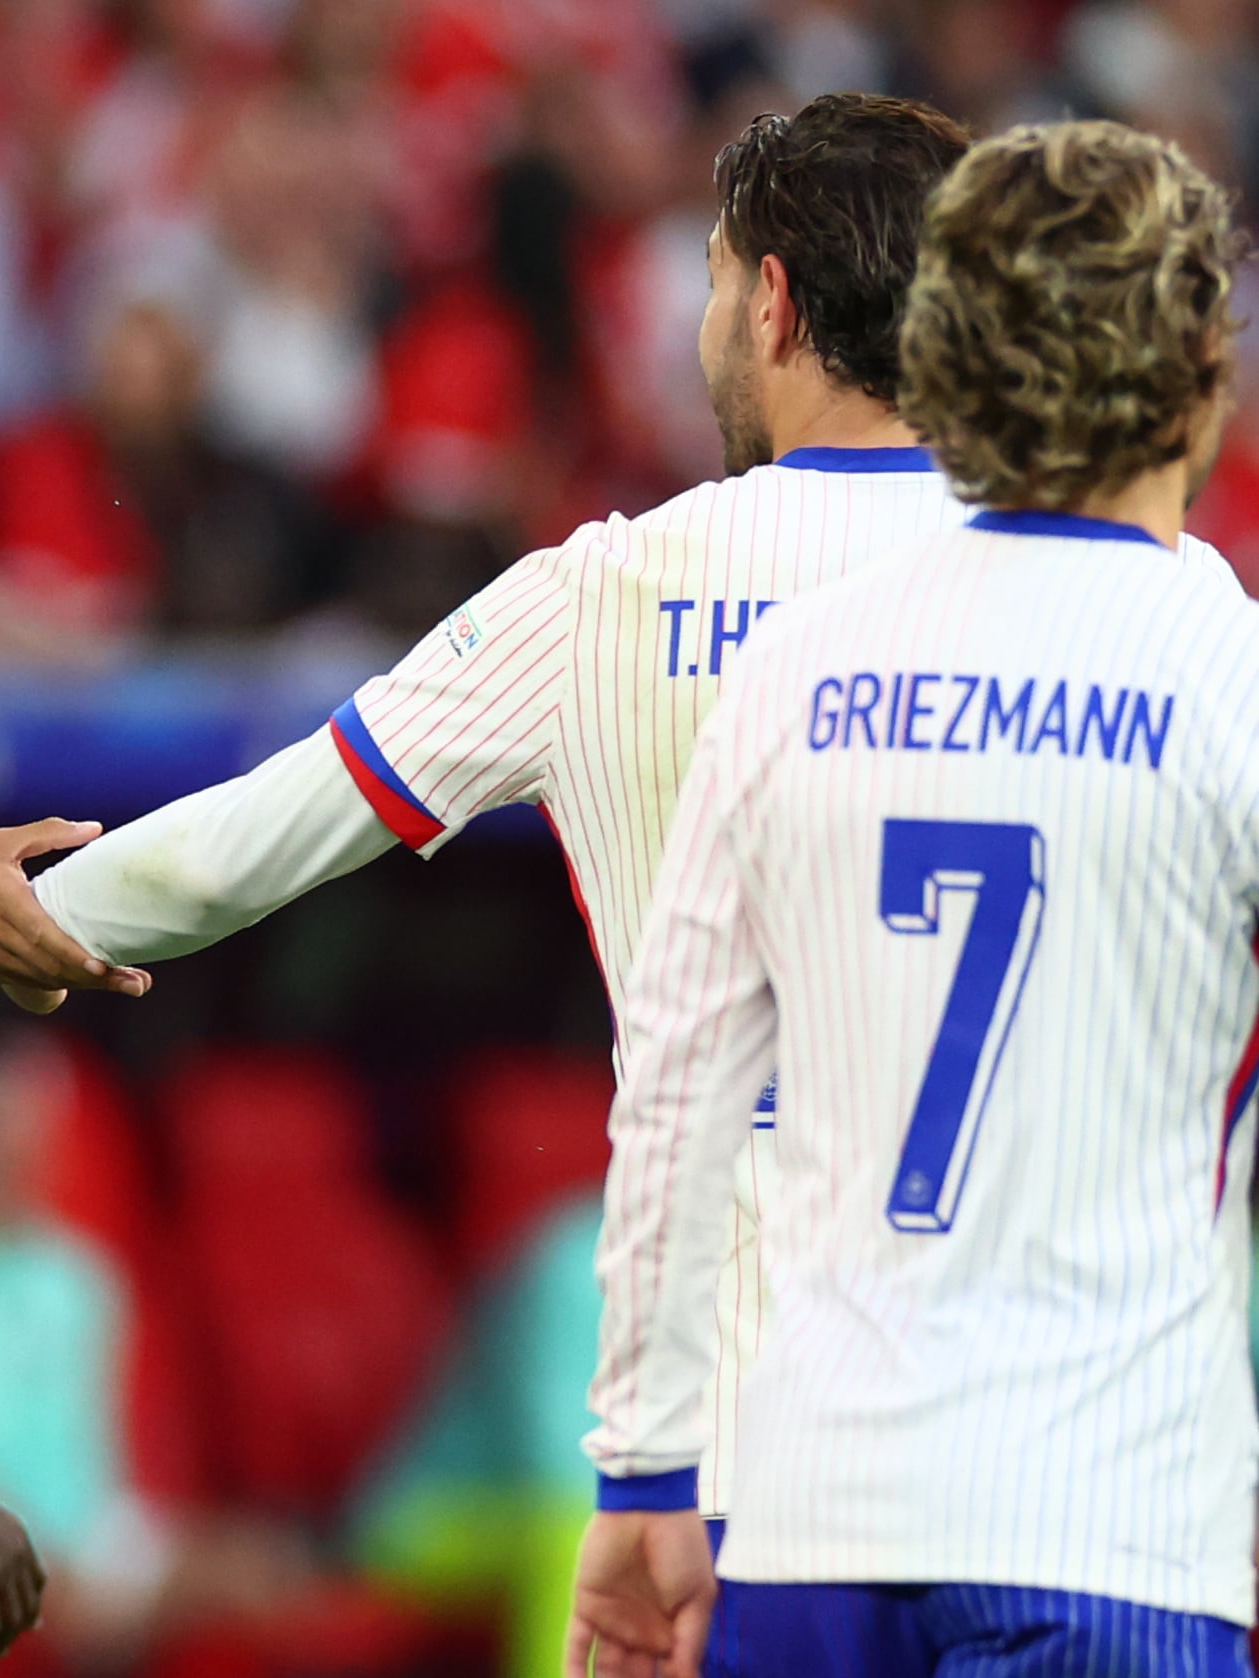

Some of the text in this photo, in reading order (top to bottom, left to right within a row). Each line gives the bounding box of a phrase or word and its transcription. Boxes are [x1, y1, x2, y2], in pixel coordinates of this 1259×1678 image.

[659, 599, 784, 677] T.H
[809, 672, 1174, 770] GRIEZMANN
[879, 818, 1046, 1233] 7
